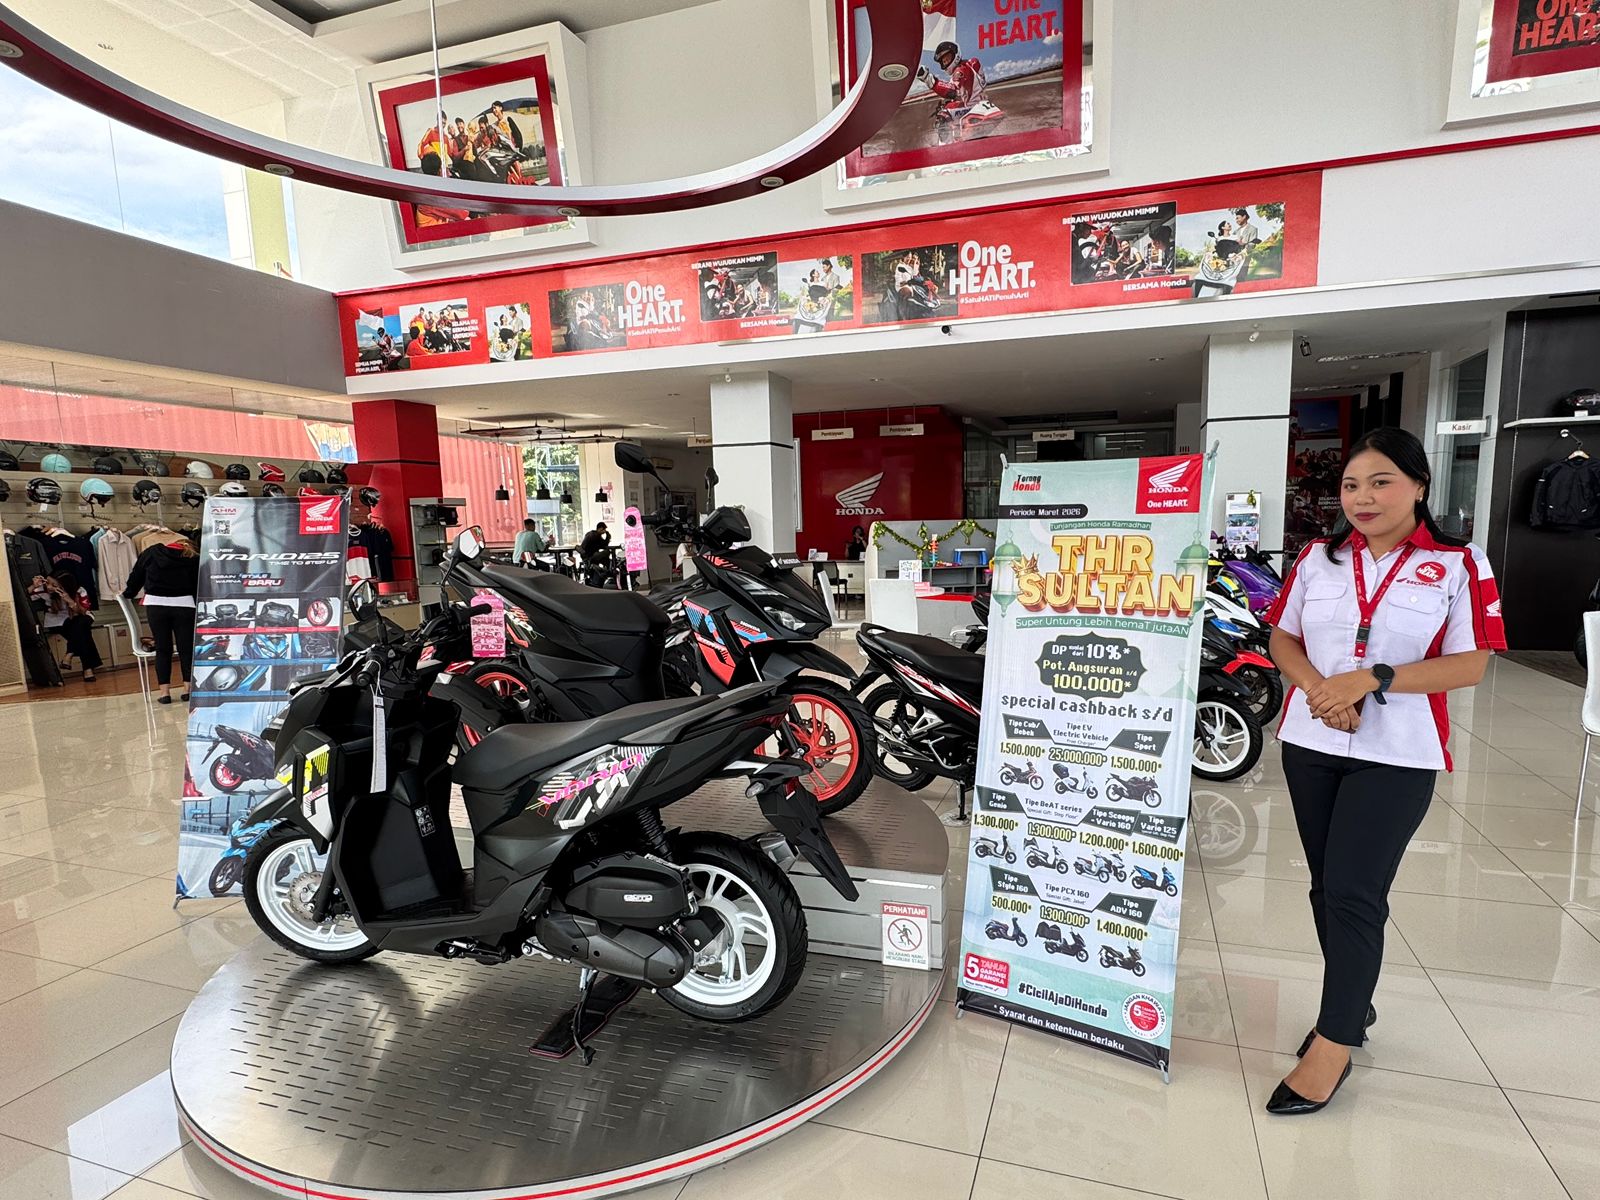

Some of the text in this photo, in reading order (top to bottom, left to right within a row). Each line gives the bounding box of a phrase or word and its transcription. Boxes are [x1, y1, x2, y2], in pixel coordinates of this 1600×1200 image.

[978, 10, 1059, 49] HEART.
[1518, 13, 1600, 50] HEAR
[1062, 206, 1158, 224] BERANI WUJUDKAN MIMPI
[960, 240, 1012, 268] One
[949, 261, 1036, 295] HEART.
[1123, 278, 1186, 291] BERSAMA Honda
[626, 280, 665, 304] One
[618, 299, 686, 328] HEART.
[1012, 482, 1040, 491] Honda
[835, 508, 884, 516] HONDA
[1051, 522, 1086, 530] Tunjangan
[1052, 535, 1154, 575] THR
[1425, 566, 1437, 574] One
[1406, 580, 1442, 589] HONDA
[1016, 572, 1195, 618] SULTAN
[1017, 618, 1190, 635] Super Untung Lebih hemaT jutaAN
[1052, 645, 1067, 655] DP
[1043, 660, 1065, 670] Pot.
[1068, 662, 1123, 676] Angsuran
[1002, 695, 1173, 722] special cashback s/d
[1009, 719, 1022, 729] Tipe
[1066, 723, 1081, 731] Tipe
[1014, 728, 1034, 736] Bebek
[1053, 730, 1109, 742] Electric Vehicle
[1137, 734, 1152, 742] Tipe
[1134, 741, 1156, 750] Sport
[992, 793, 1005, 801] Tipe
[989, 801, 1007, 810] Genio
[1025, 798, 1082, 813] Tipe BeAT series
[1092, 809, 1135, 823] Tipe Scoopy
[1149, 816, 1164, 825] Tipe
[1096, 818, 1116, 827] Vario
[1117, 821, 1131, 830] 160
[1141, 822, 1162, 831] Vario
[1163, 826, 1177, 834] 125
[1004, 874, 1018, 883] Tipe
[997, 881, 1028, 893] Style 160
[1045, 883, 1090, 898] Tipe PCX 160
[1122, 899, 1139, 908] Tipe
[884, 905, 925, 916] PERHATIAN!
[1110, 906, 1142, 918] ADV 160
[966, 957, 979, 978] 5
[980, 960, 1007, 972] TAHUN
[980, 968, 1006, 979] GARANSI
[980, 974, 1005, 984] RANGKA
[1124, 994, 1140, 1011] JANGAN
[1133, 1004, 1142, 1016] 5
[999, 1006, 1025, 1021] Syarat
[1028, 1015, 1043, 1026] dan
[1046, 1020, 1088, 1039] ketentuan
[1091, 1033, 1124, 1050] berlaku
